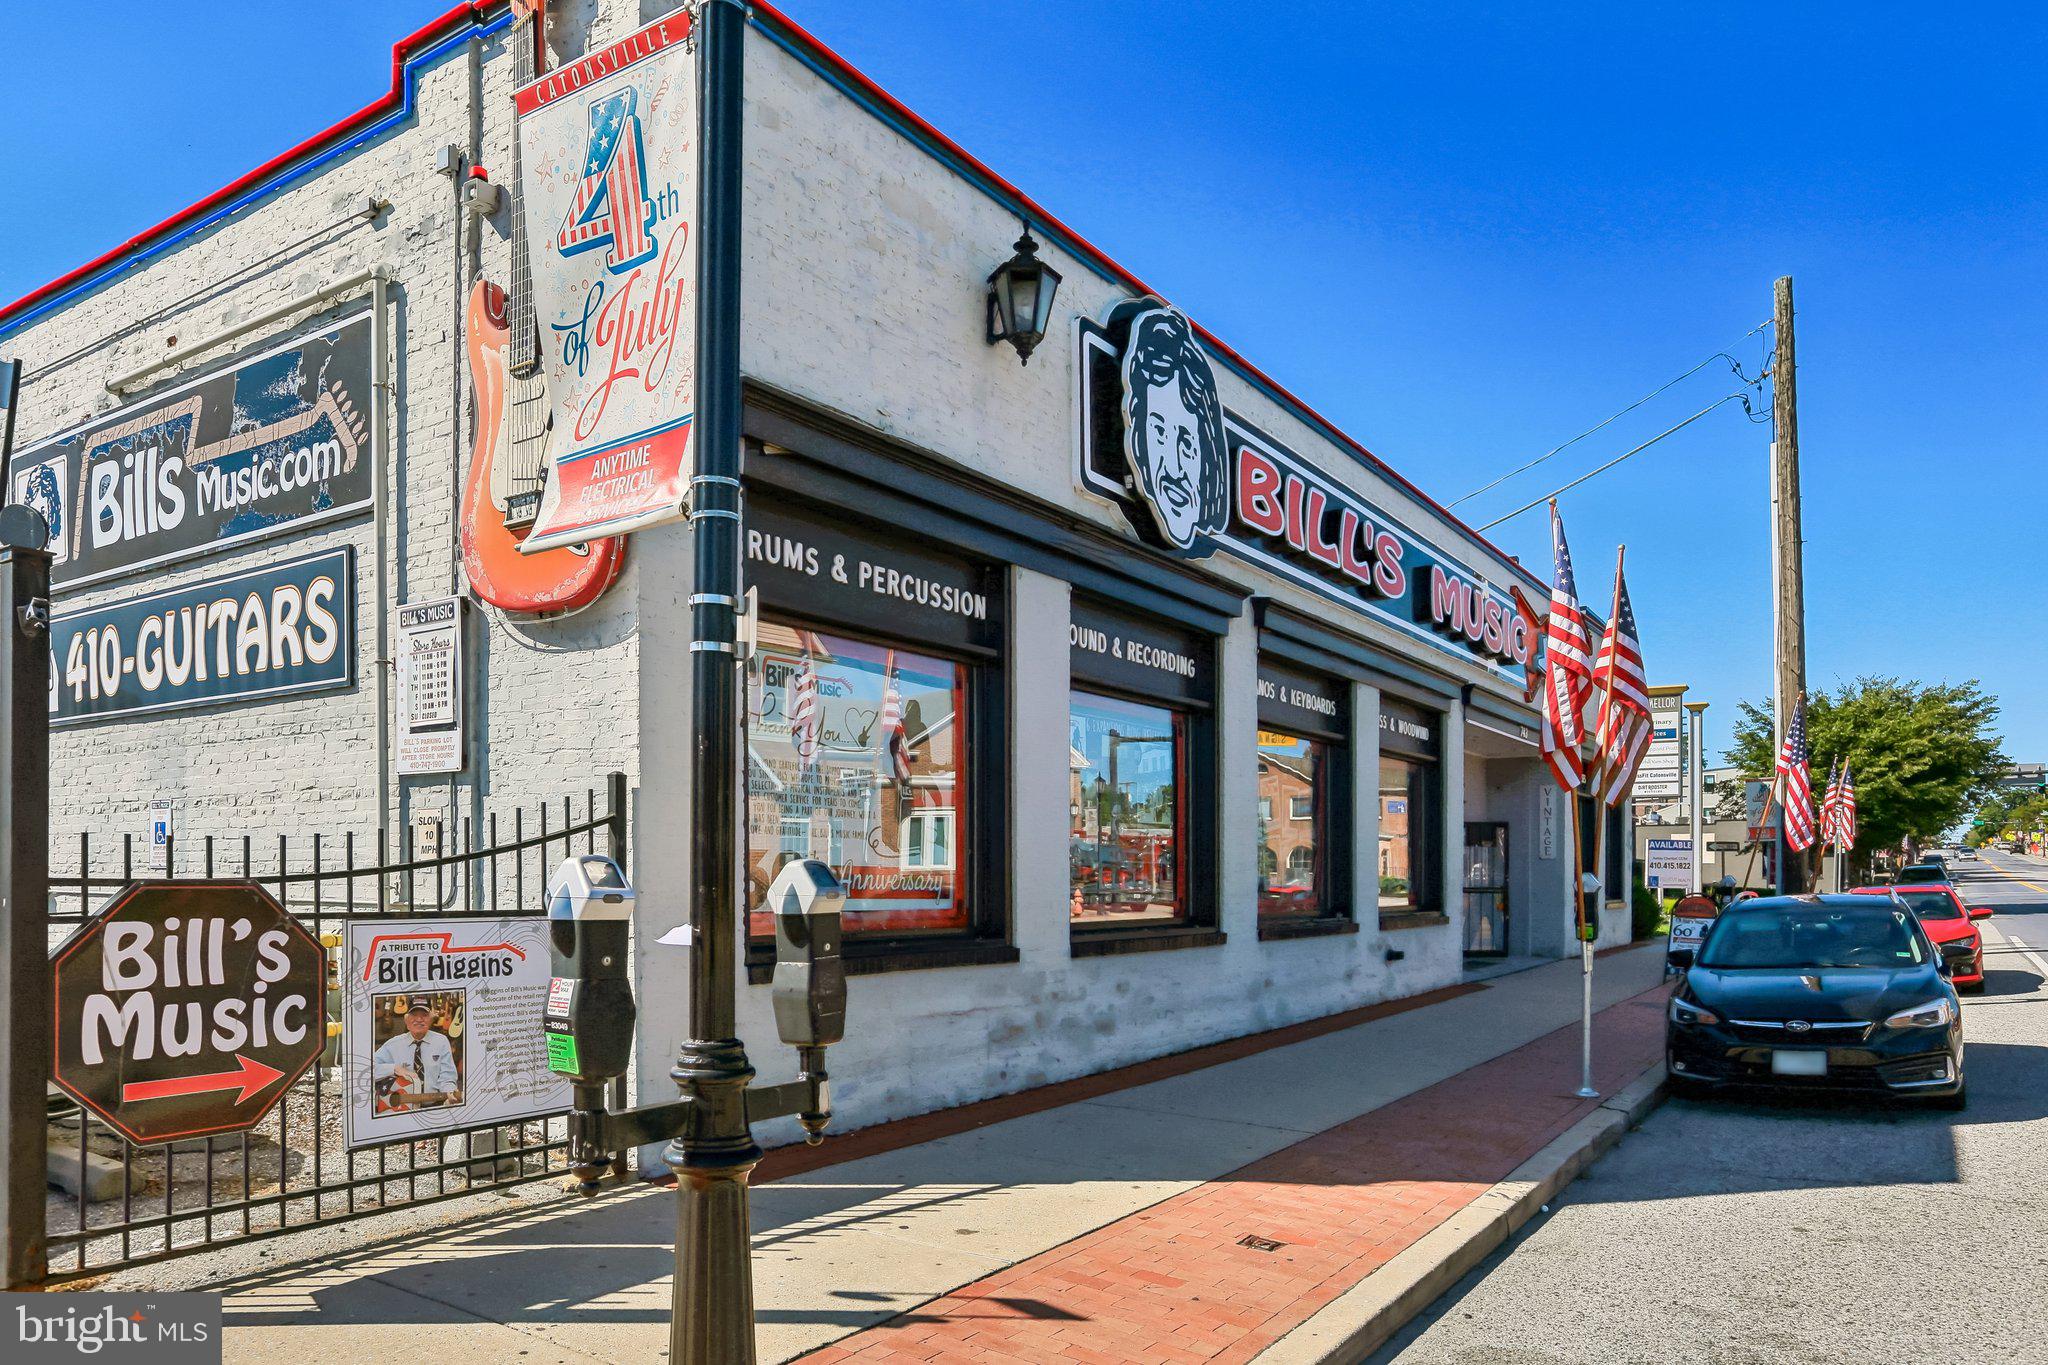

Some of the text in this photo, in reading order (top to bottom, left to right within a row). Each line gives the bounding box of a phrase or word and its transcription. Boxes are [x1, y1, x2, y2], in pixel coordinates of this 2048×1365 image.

[536, 24, 670, 104] CATONSVILLE
[551, 221, 689, 441] of July
[591, 445, 651, 479] ANYTIME
[92, 440, 340, 549] Bills Music.com
[581, 471, 655, 503] ELECTRICAL
[1237, 445, 1528, 664] BILL'S MUSIC
[748, 530, 986, 620] RUMS & PERCUSSION
[402, 604, 453, 626] BILL'S MUSIC
[66, 576, 338, 702] 410-GUITARS
[413, 636, 450, 652] Store Hours
[1070, 624, 1195, 677] OUND & RECORDING
[1257, 679, 1336, 716] NOS & KEYBOARDS
[419, 816, 440, 825] SLOW
[425, 831, 433, 839] 10
[103, 917, 290, 991] Bill's
[389, 943, 426, 952] TRIBUTE
[379, 953, 513, 983] Bill Higgins
[553, 981, 560, 992] 2
[82, 980, 307, 1065] Music
[551, 1022, 568, 1030] 83049
